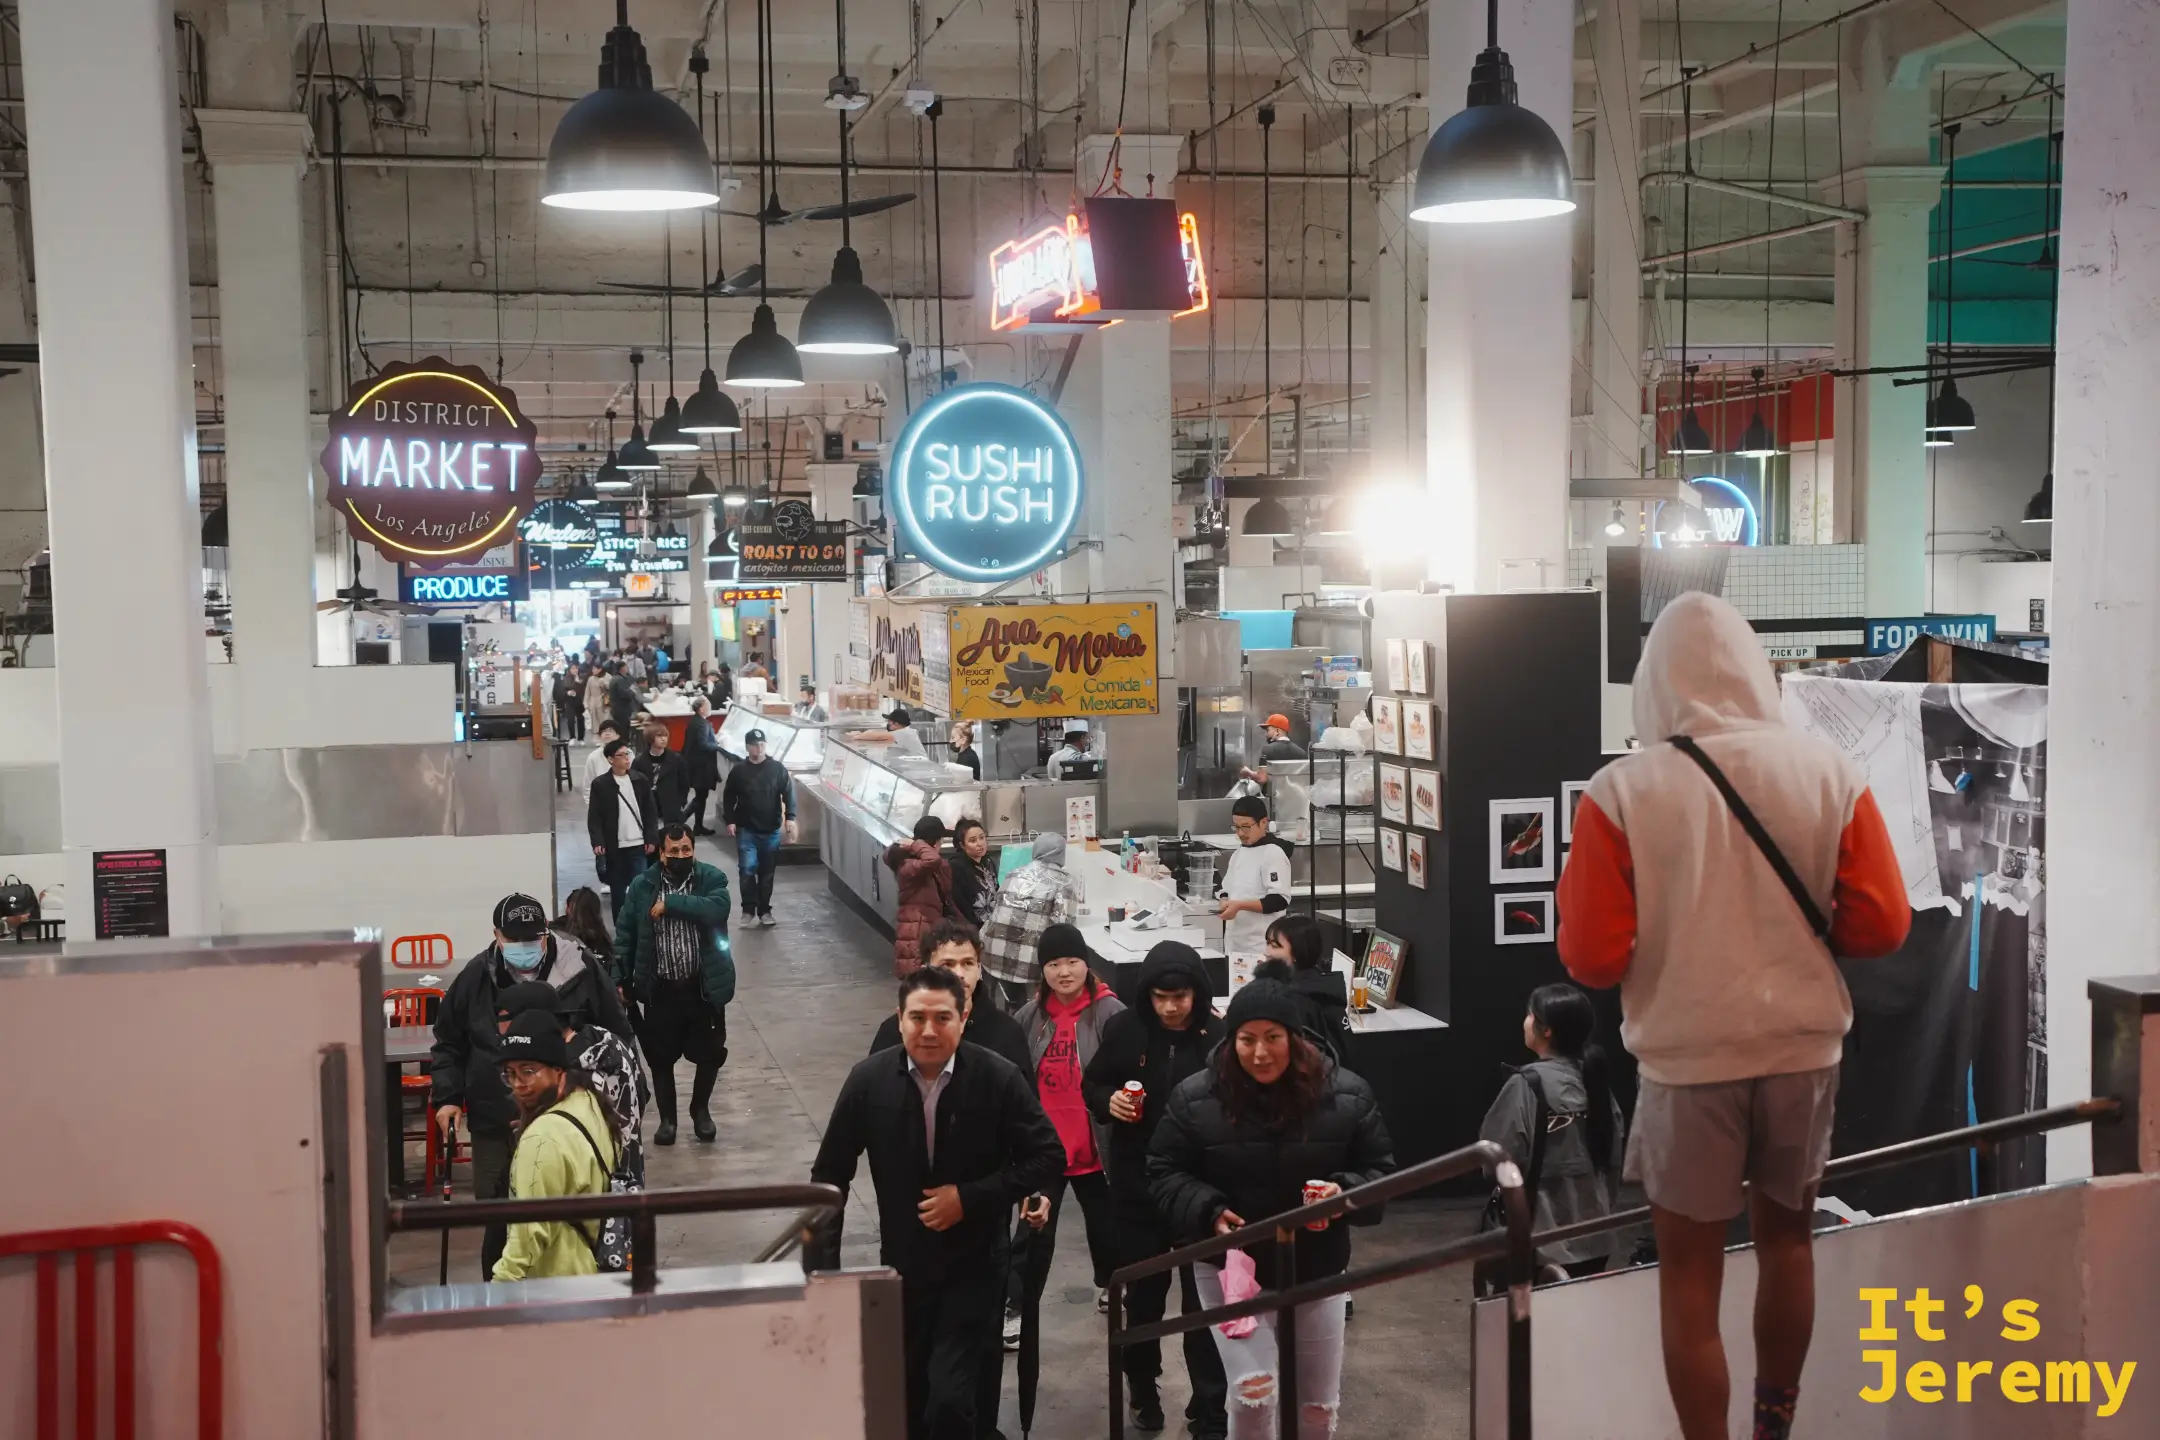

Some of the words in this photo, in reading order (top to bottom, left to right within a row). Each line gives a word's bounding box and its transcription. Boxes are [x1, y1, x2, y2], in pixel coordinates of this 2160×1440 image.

[374, 399, 495, 428] DISTRICT
[340, 436, 528, 493] MARKET
[924, 442, 1054, 483] SUSHI
[926, 484, 1054, 524] RUSH
[374, 503, 405, 532] Los
[411, 510, 492, 543] Angeles
[603, 537, 652, 551] STIC
[656, 536, 687, 549] RICE
[744, 544, 795, 560] ROAST
[799, 545, 819, 560] TO
[822, 544, 845, 560] GO
[744, 561, 788, 576] antojitos
[791, 562, 846, 574] mexicanos
[413, 574, 509, 600] PRODUCE
[723, 589, 782, 600] PIZZA
[957, 617, 1042, 668] Ana
[1941, 622, 1989, 643] WIN
[1044, 630, 1147, 677] Maria
[1770, 648, 1792, 657] PICK
[1796, 648, 1808, 657] UP
[956, 666, 995, 677] Mexican
[964, 676, 990, 687] Food
[1083, 677, 1142, 694] Comida
[1080, 694, 1148, 712] Mexicana
[1366, 966, 1390, 991] OPEN
